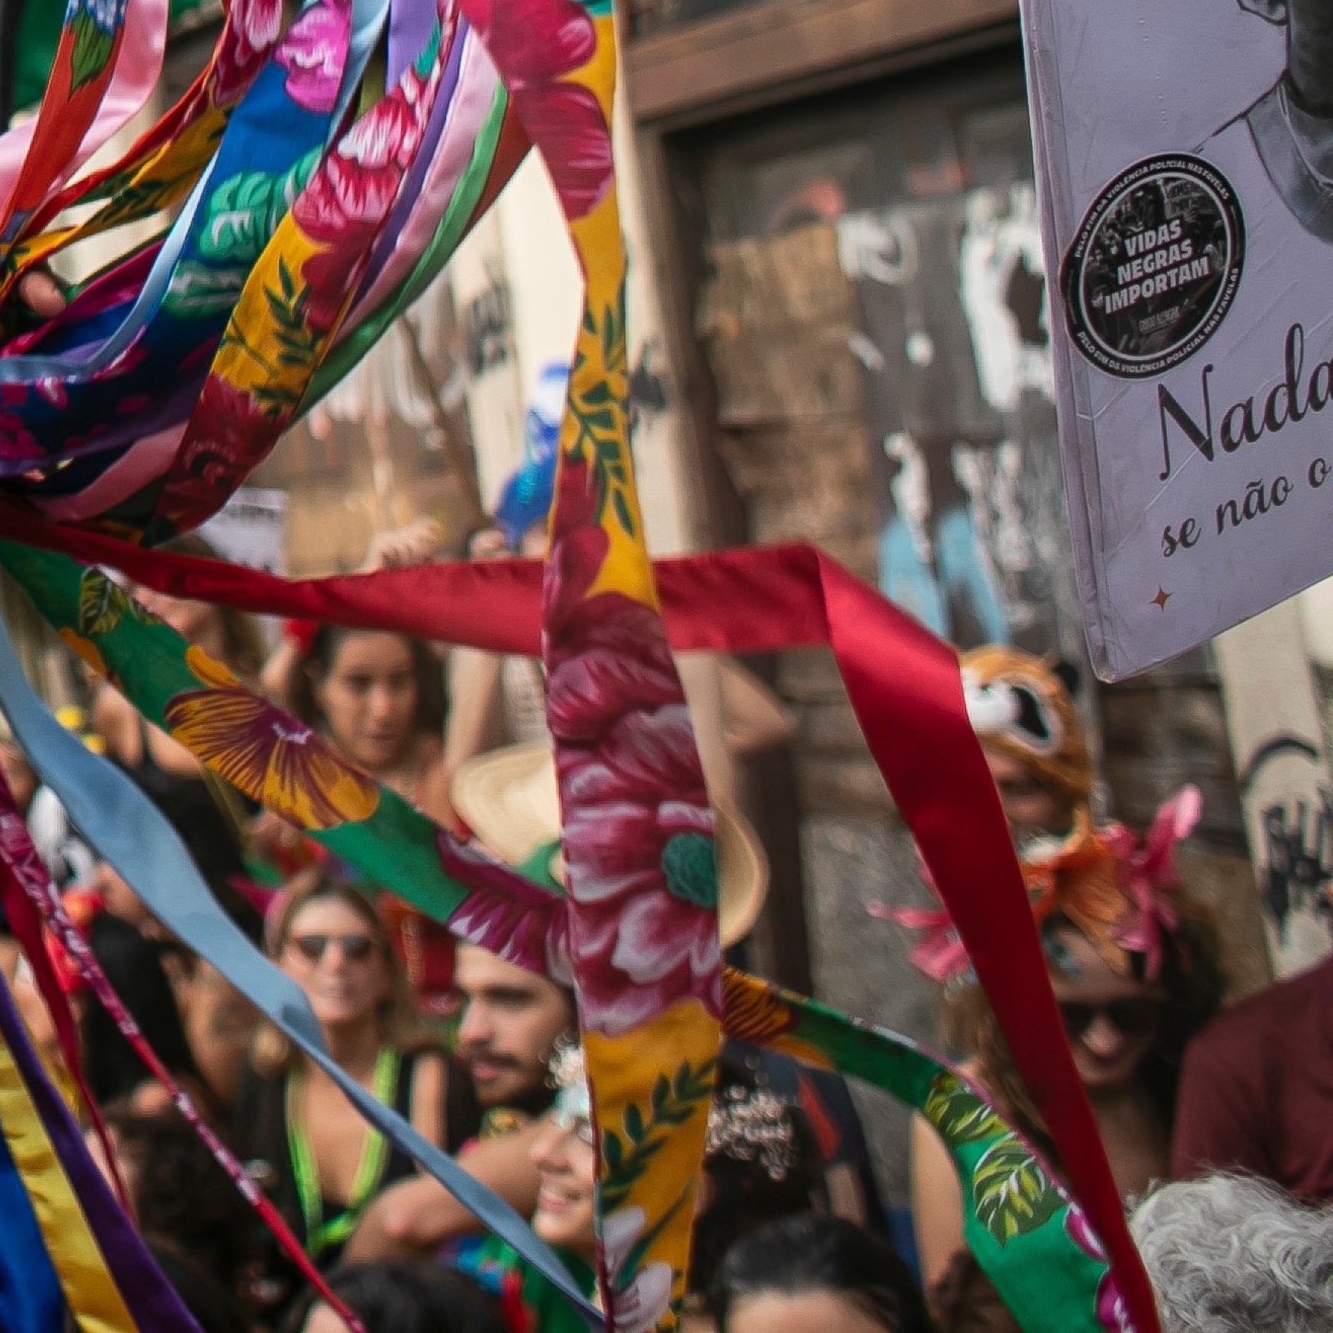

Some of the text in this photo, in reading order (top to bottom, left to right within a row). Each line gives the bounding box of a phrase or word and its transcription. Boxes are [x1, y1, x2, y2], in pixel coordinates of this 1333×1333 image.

[1074, 231, 1089, 258] PELO
[1085, 211, 1098, 230] FIM
[1096, 198, 1108, 212] DA
[1149, 160, 1186, 171] POLICIAL
[1187, 162, 1203, 174] NAS
[1202, 170, 1230, 199] FAVELAS
[1124, 219, 1183, 258] VIDAS
[1104, 256, 1210, 314] IMPORTAM
[1117, 239, 1193, 285] NEGRAS
[1076, 331, 1095, 353] PELO
[1094, 350, 1110, 364] FIM
[1108, 360, 1120, 370] DA
[1166, 334, 1205, 364] POLICIAL
[1203, 313, 1220, 334] NAS
[1217, 268, 1239, 314] FAVELAS
[1158, 323, 1333, 481] Nada
[1161, 517, 1202, 557] se
[1216, 478, 1294, 535] não
